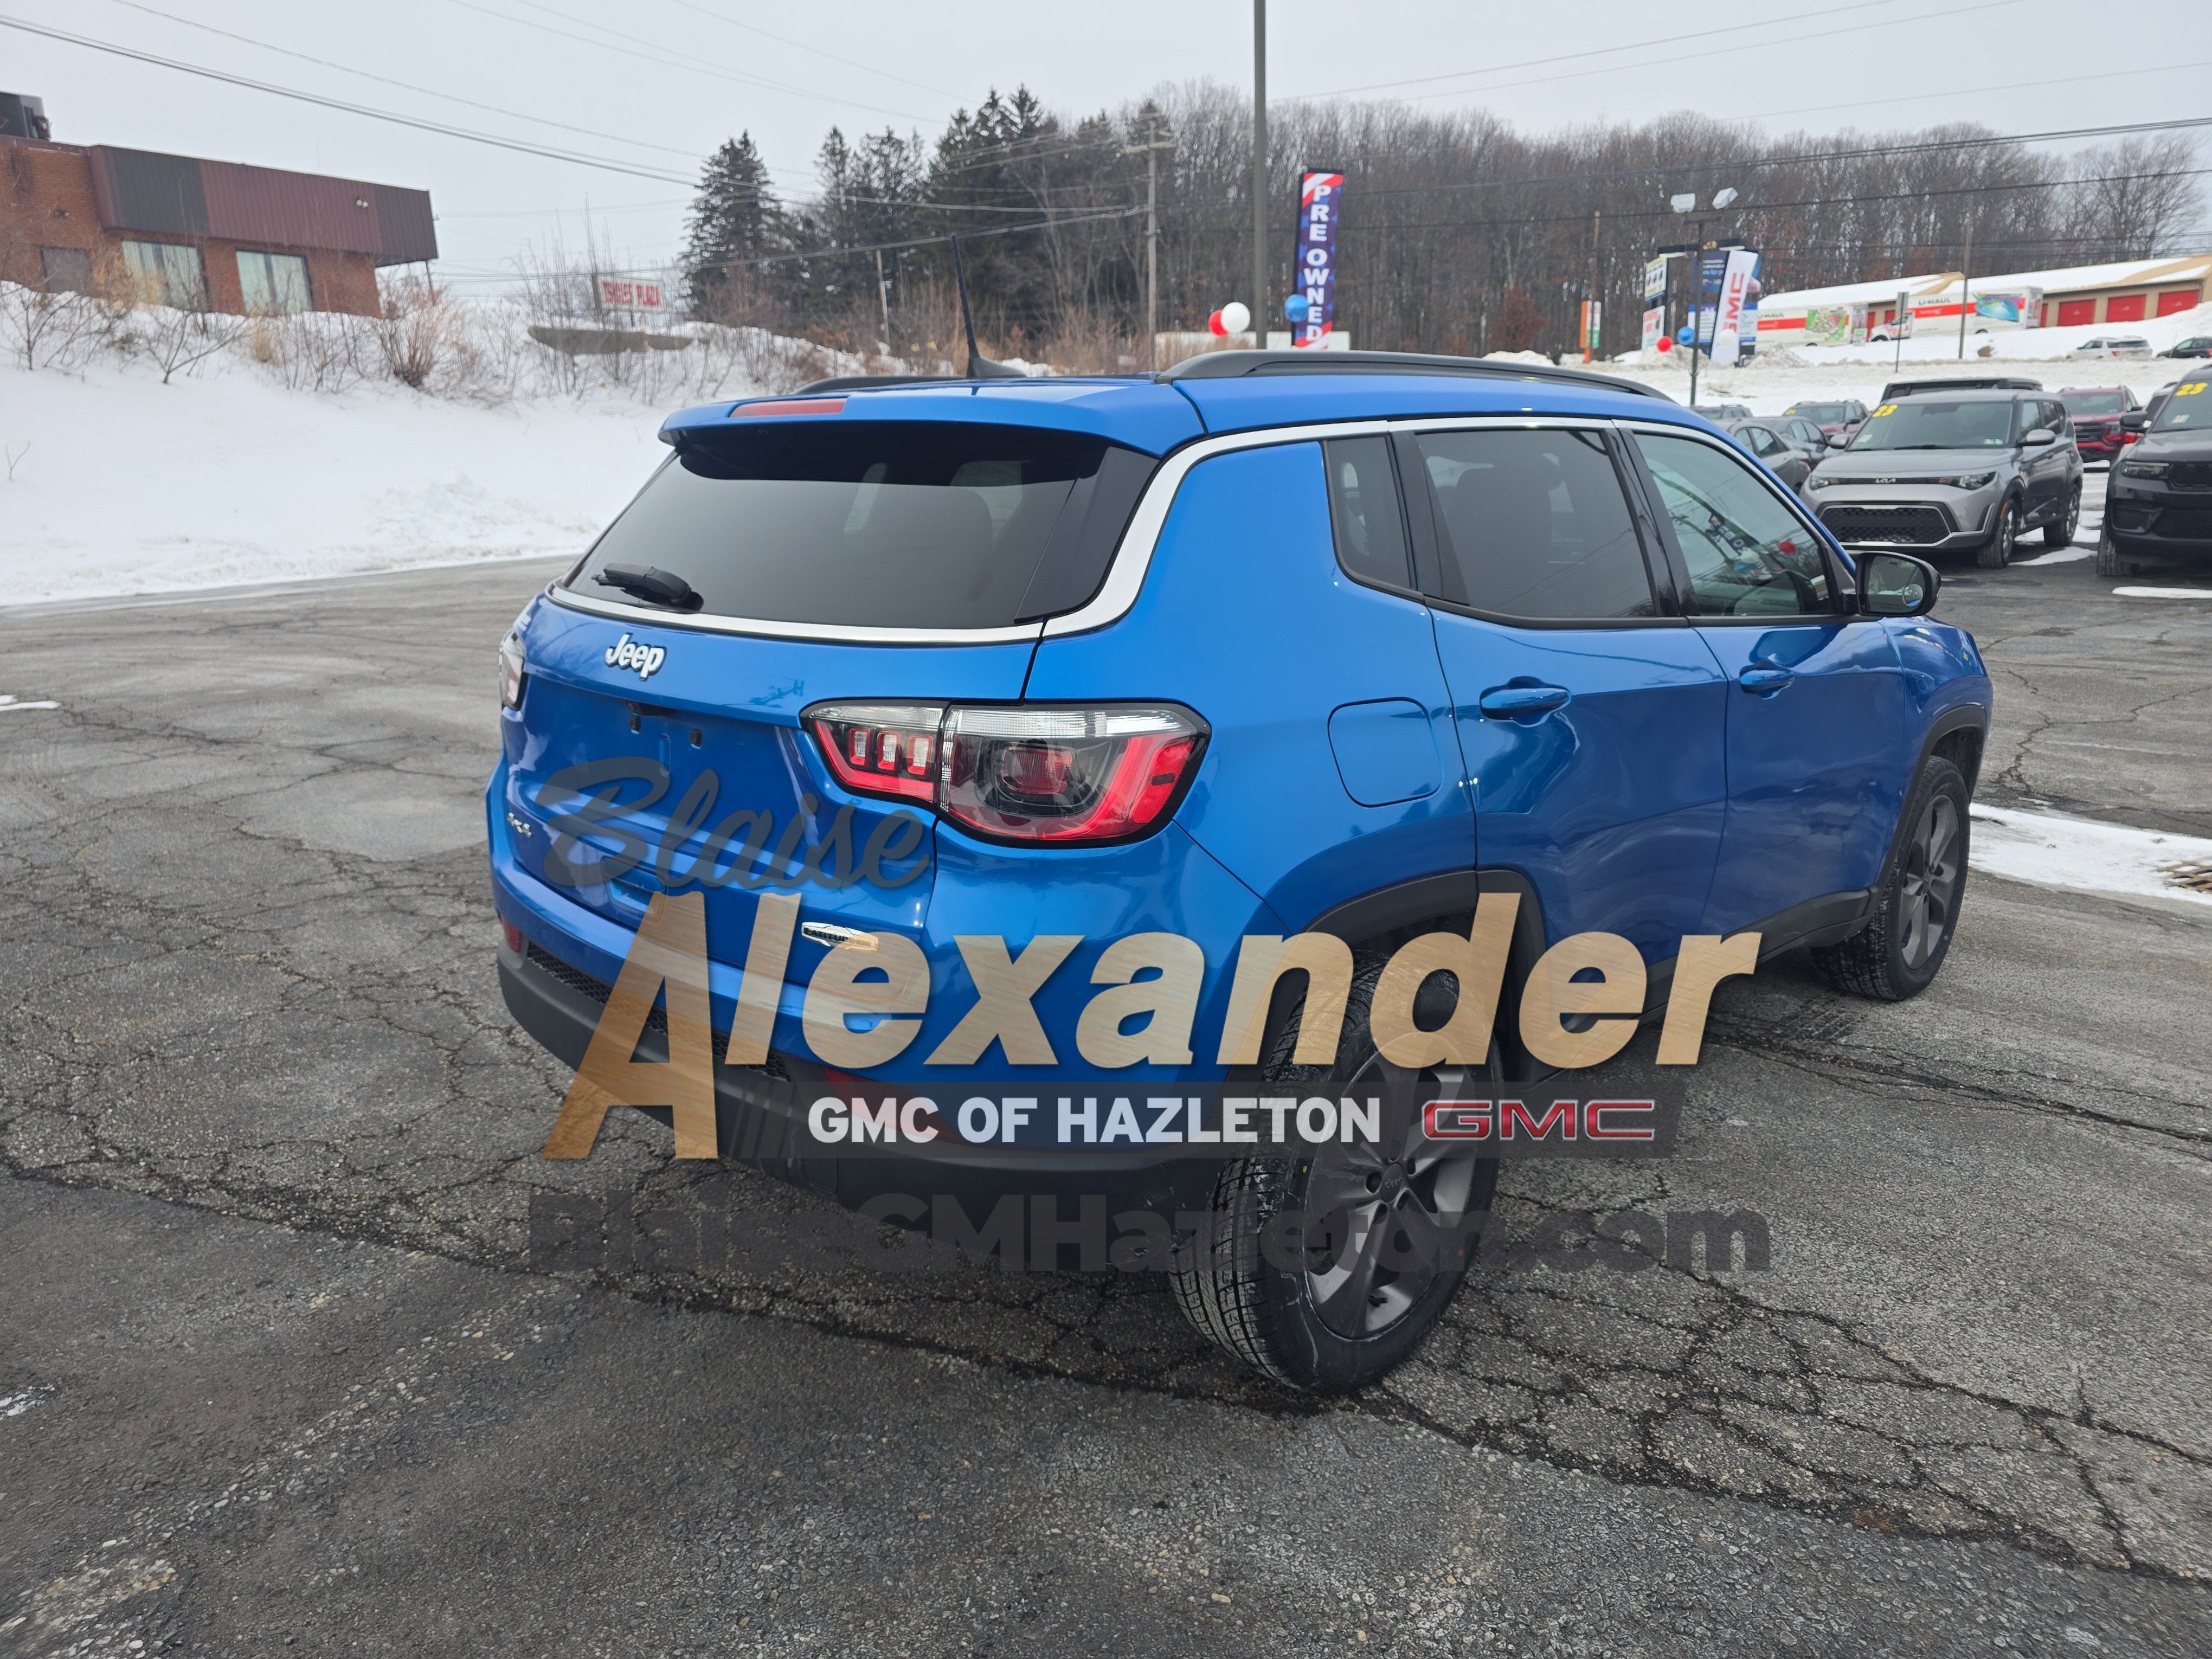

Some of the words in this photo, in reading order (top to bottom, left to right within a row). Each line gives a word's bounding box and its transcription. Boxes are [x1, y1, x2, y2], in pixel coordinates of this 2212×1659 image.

[1309, 185, 1332, 242] PRE
[1303, 248, 1330, 341] OWNED
[1872, 404, 1899, 418] 23
[2174, 382, 2209, 397] 23
[605, 632, 667, 681] Jeep
